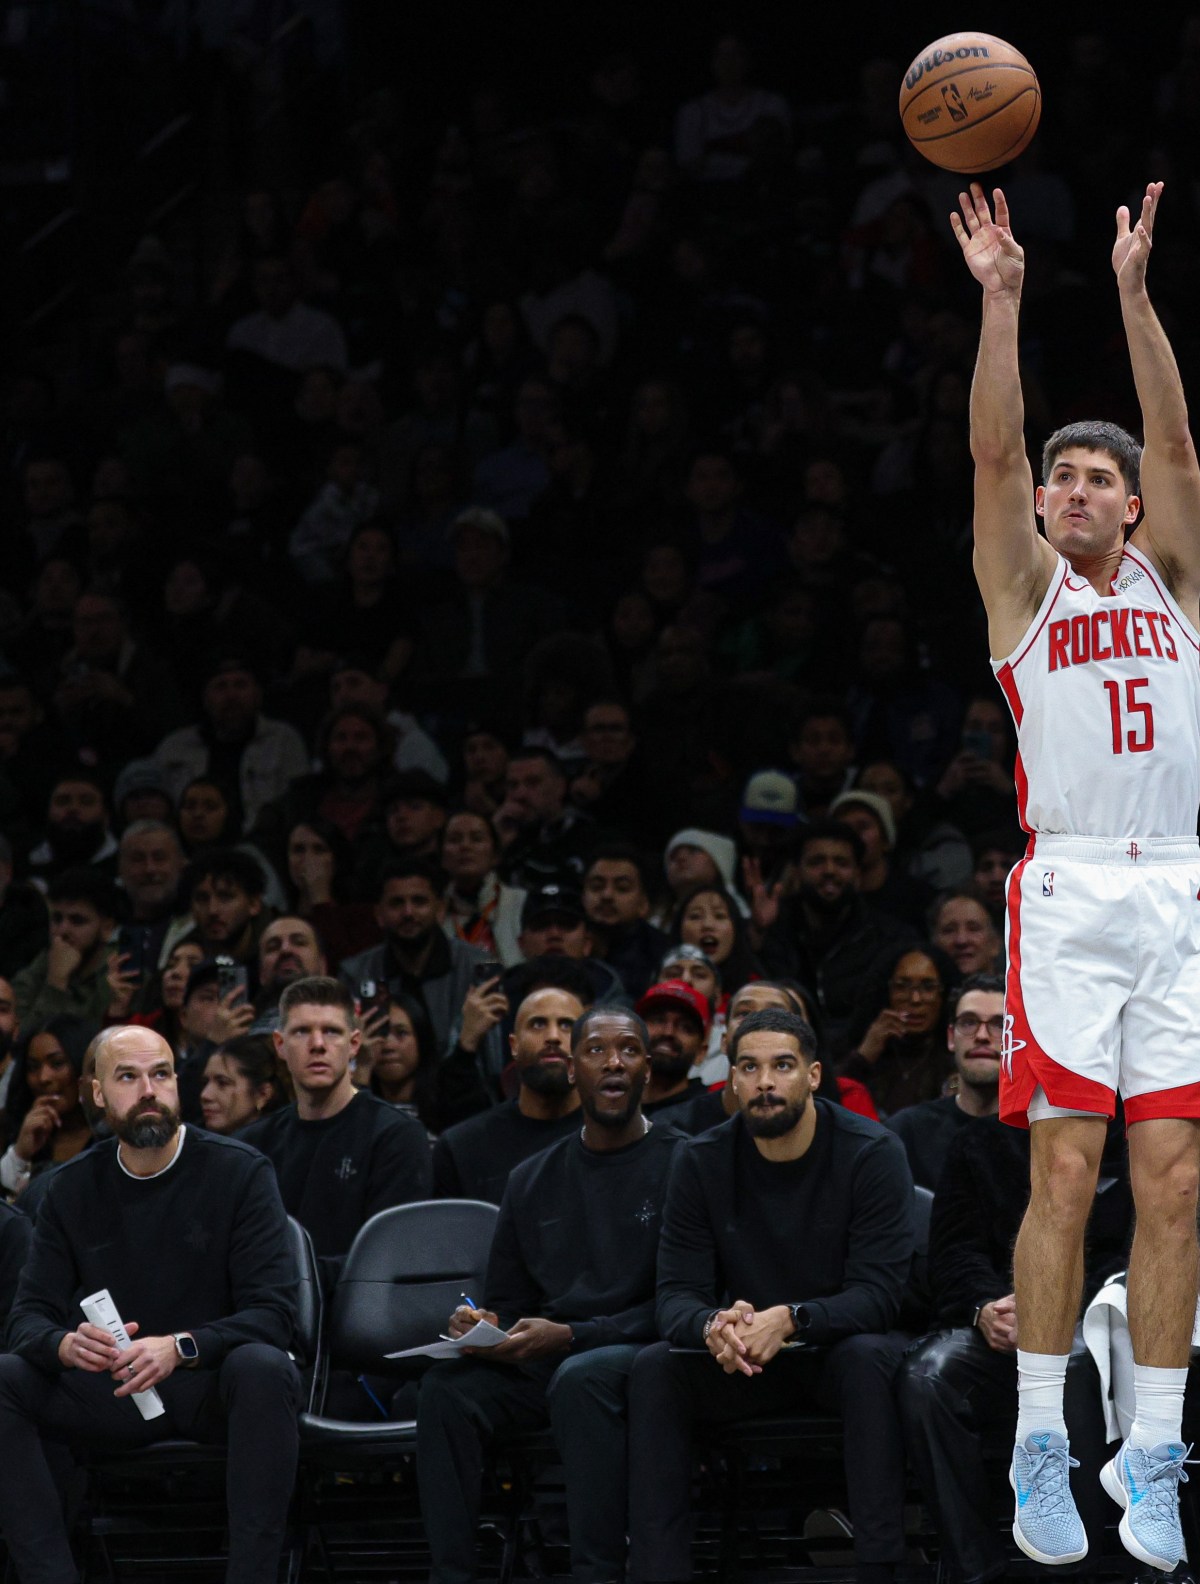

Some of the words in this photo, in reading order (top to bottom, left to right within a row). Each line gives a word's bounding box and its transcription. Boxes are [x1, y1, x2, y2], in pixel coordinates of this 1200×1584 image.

[904, 46, 990, 90] Wilson
[1048, 607, 1179, 674] ROCKETS
[1104, 677, 1155, 755] 15
